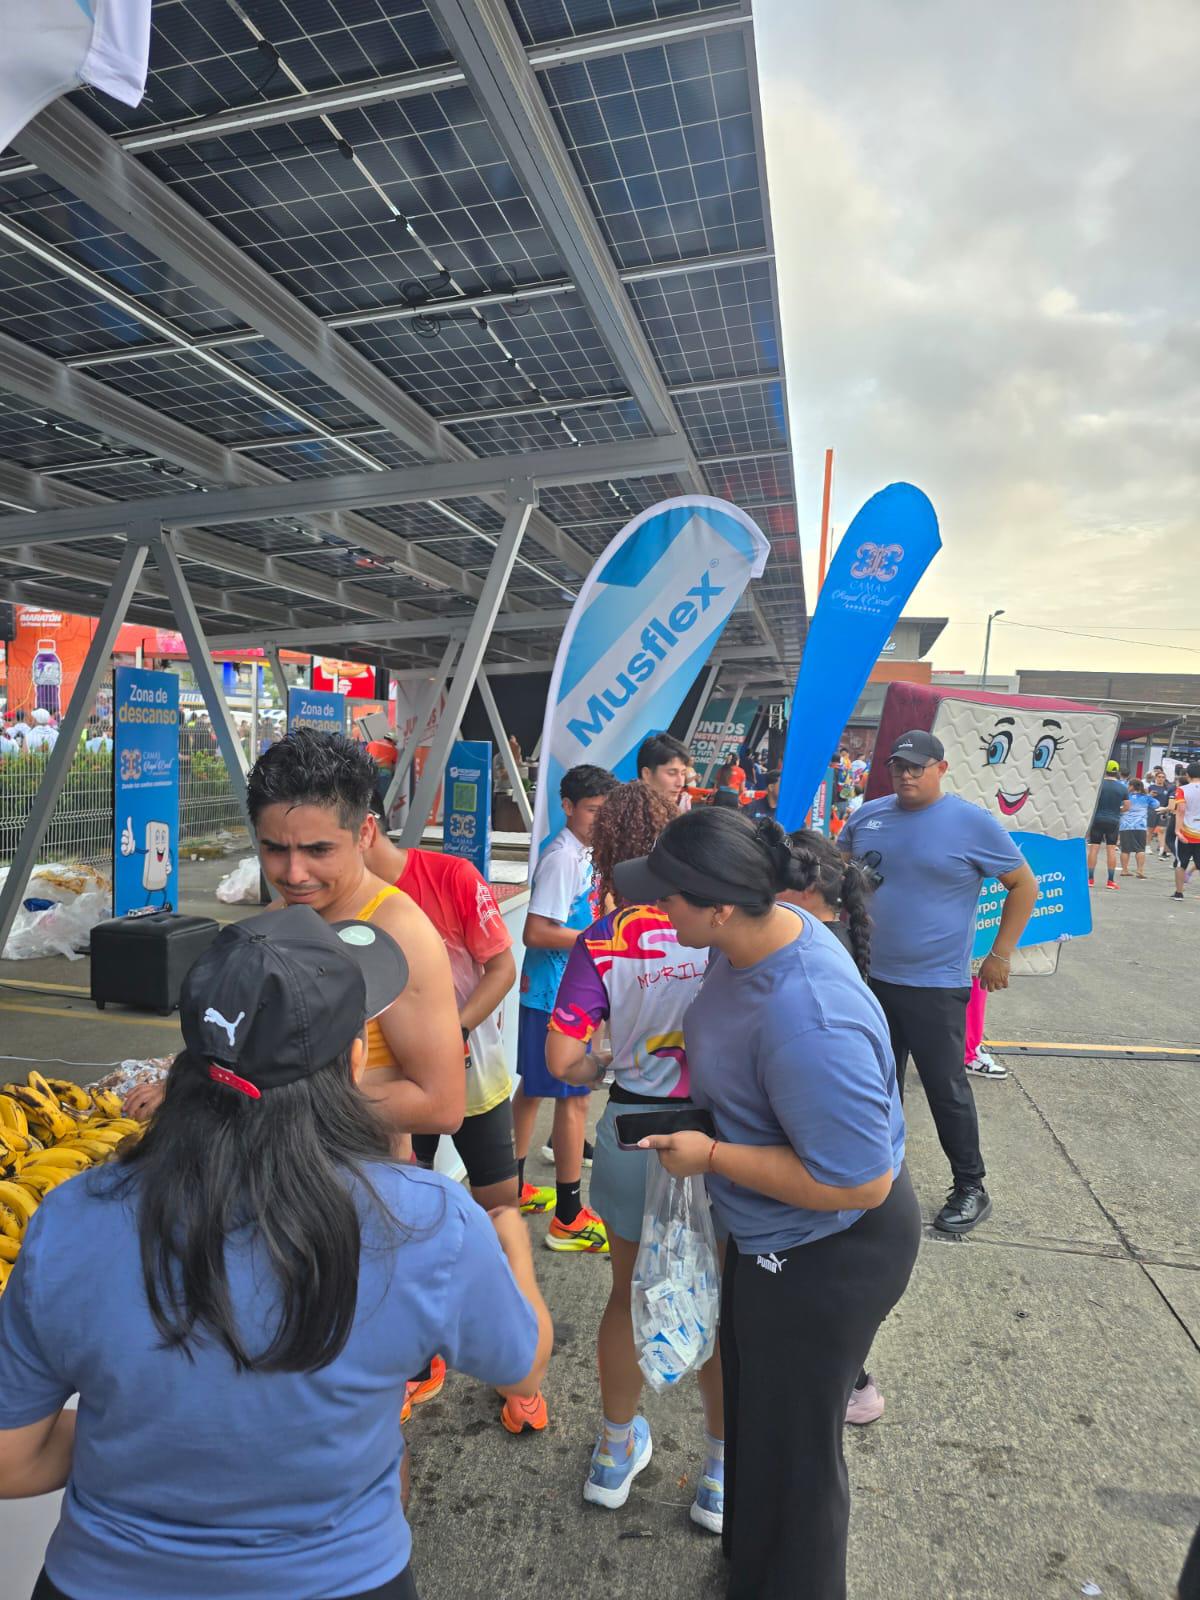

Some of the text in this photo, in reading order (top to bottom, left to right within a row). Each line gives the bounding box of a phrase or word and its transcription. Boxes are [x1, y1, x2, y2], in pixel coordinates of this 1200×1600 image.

[566, 569, 726, 748] Musflex
[130, 684, 154, 702] Zona
[155, 688, 168, 704] de
[118, 701, 177, 725] descanso
[301, 702, 335, 716] Zona de
[291, 715, 342, 732] descanso
[721, 743, 739, 753] FE
[1035, 871, 1066, 884] erzo,
[976, 900, 998, 915] rpo
[1046, 887, 1063, 898] un
[1030, 903, 1064, 919] anso
[756, 1255, 777, 1274] PUMA
